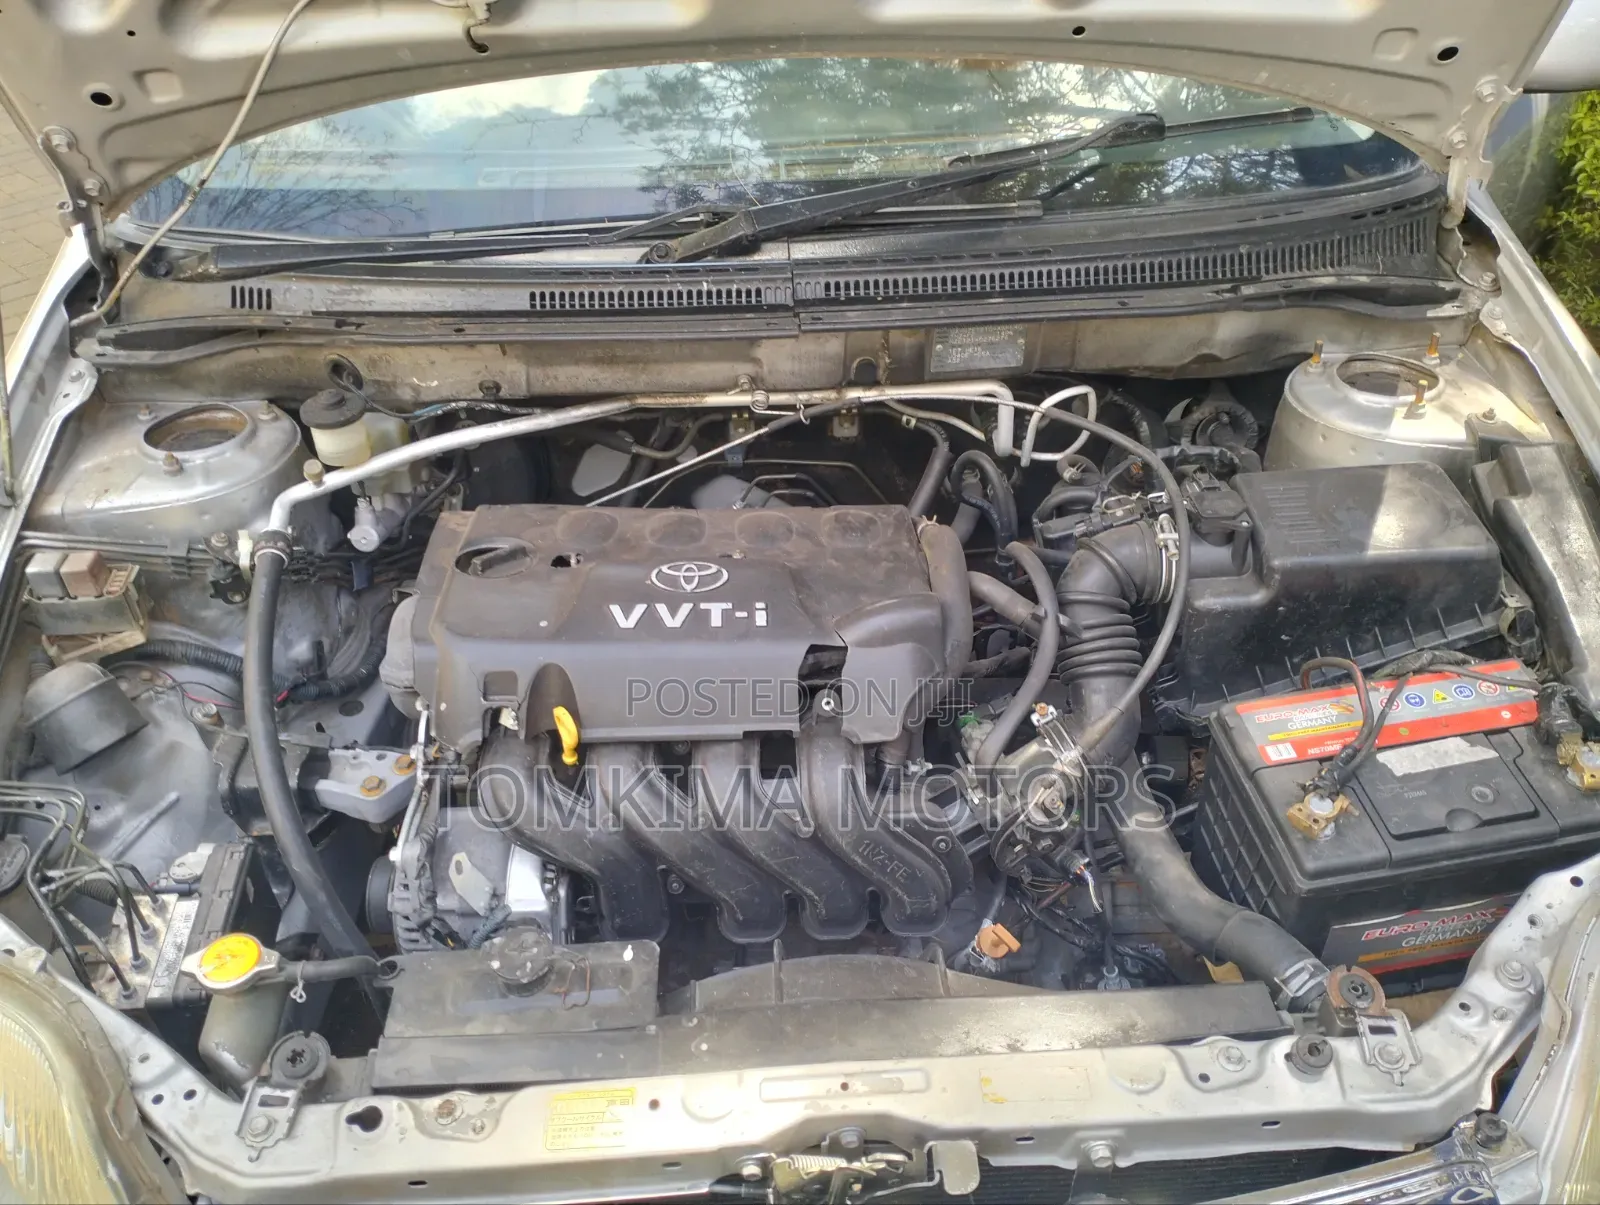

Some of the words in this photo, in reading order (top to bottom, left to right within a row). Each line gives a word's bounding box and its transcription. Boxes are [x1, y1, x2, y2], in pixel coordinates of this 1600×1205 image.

[608, 602, 768, 628] VVT-i
[1287, 715, 1338, 731] GERMANY
[1401, 924, 1488, 947] GERMANY
